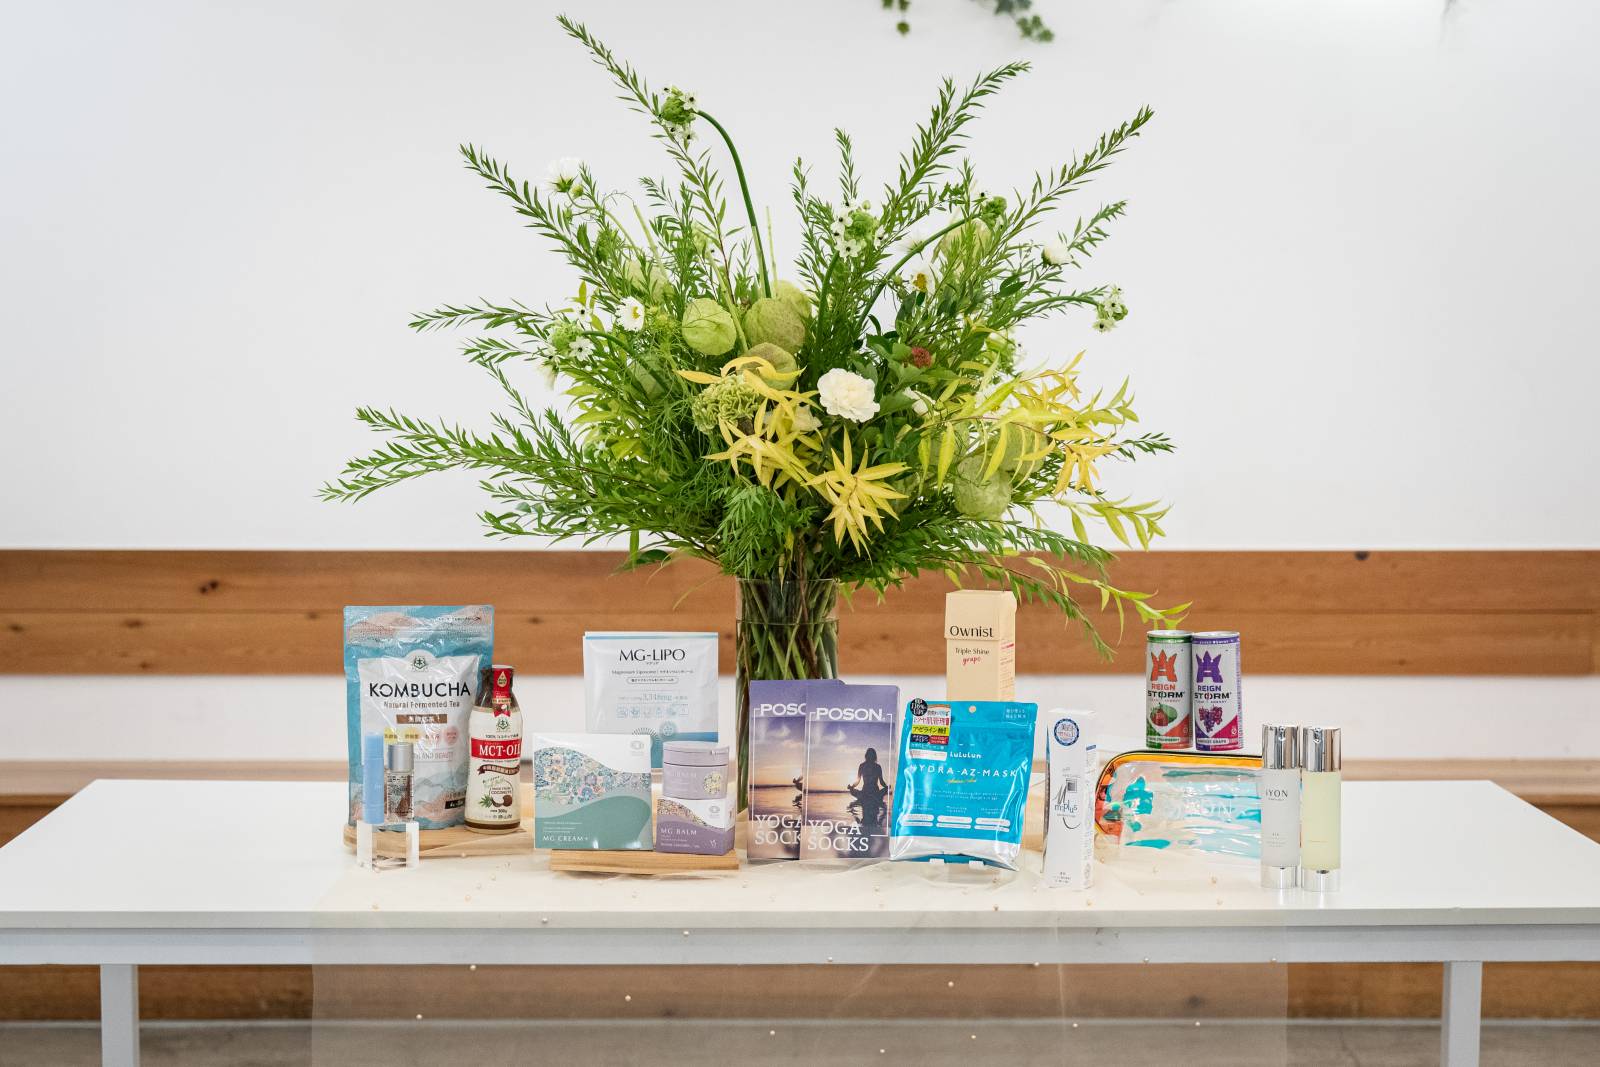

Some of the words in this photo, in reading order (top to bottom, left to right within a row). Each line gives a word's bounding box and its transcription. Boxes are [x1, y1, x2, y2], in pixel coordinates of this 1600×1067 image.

[949, 625, 994, 638] Ownist
[619, 648, 686, 661] MG-LIPO
[955, 647, 971, 656] Triple
[972, 647, 990, 655] Shine
[962, 656, 981, 666] grape
[369, 682, 471, 698] KOMBUCHA
[1147, 690, 1184, 699] STORM
[1194, 692, 1230, 700] STORM
[383, 701, 409, 709] Natural
[410, 701, 448, 709] Fermented
[449, 700, 460, 708] Tea
[816, 707, 883, 721] POSON
[676, 828, 697, 836] BALM
[808, 820, 862, 835] YOGA
[807, 837, 869, 852] SOCKS
